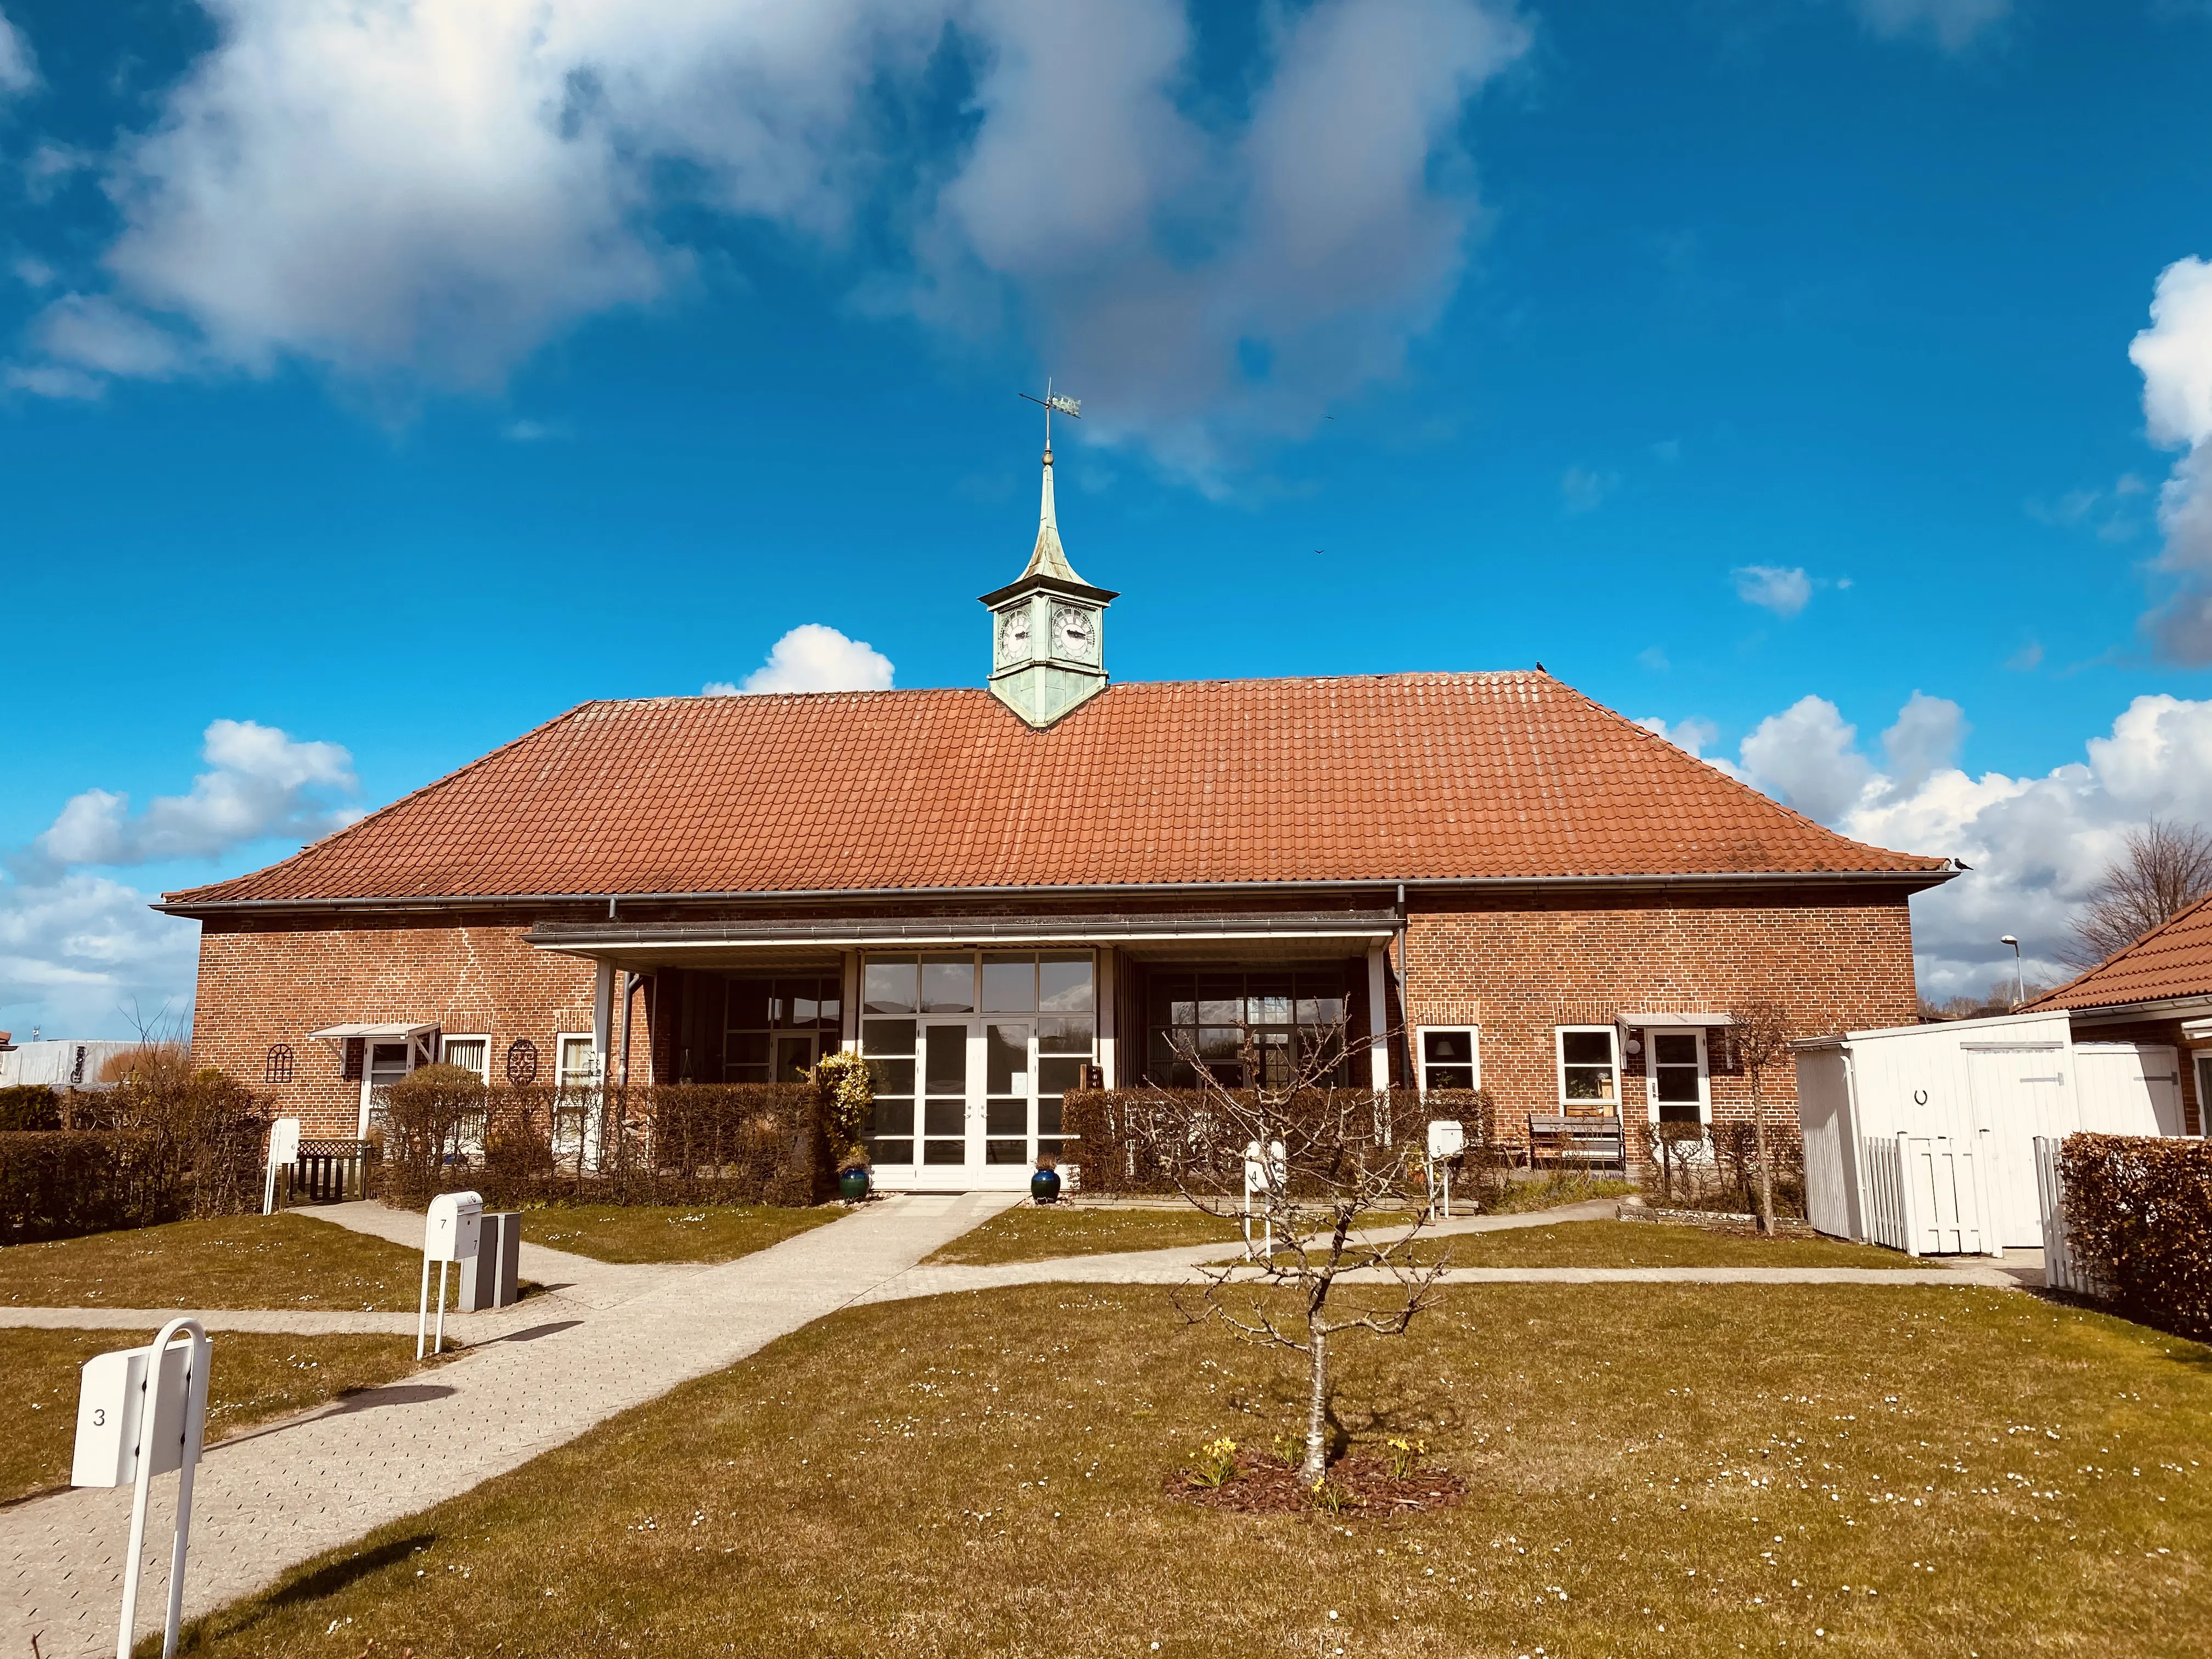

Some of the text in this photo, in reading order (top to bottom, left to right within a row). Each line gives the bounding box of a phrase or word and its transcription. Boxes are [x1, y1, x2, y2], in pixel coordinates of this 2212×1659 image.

[1252, 1171, 1257, 1182] 4
[441, 1219, 447, 1229] 7
[474, 1240, 477, 1250] 7
[93, 1409, 105, 1426] 3
